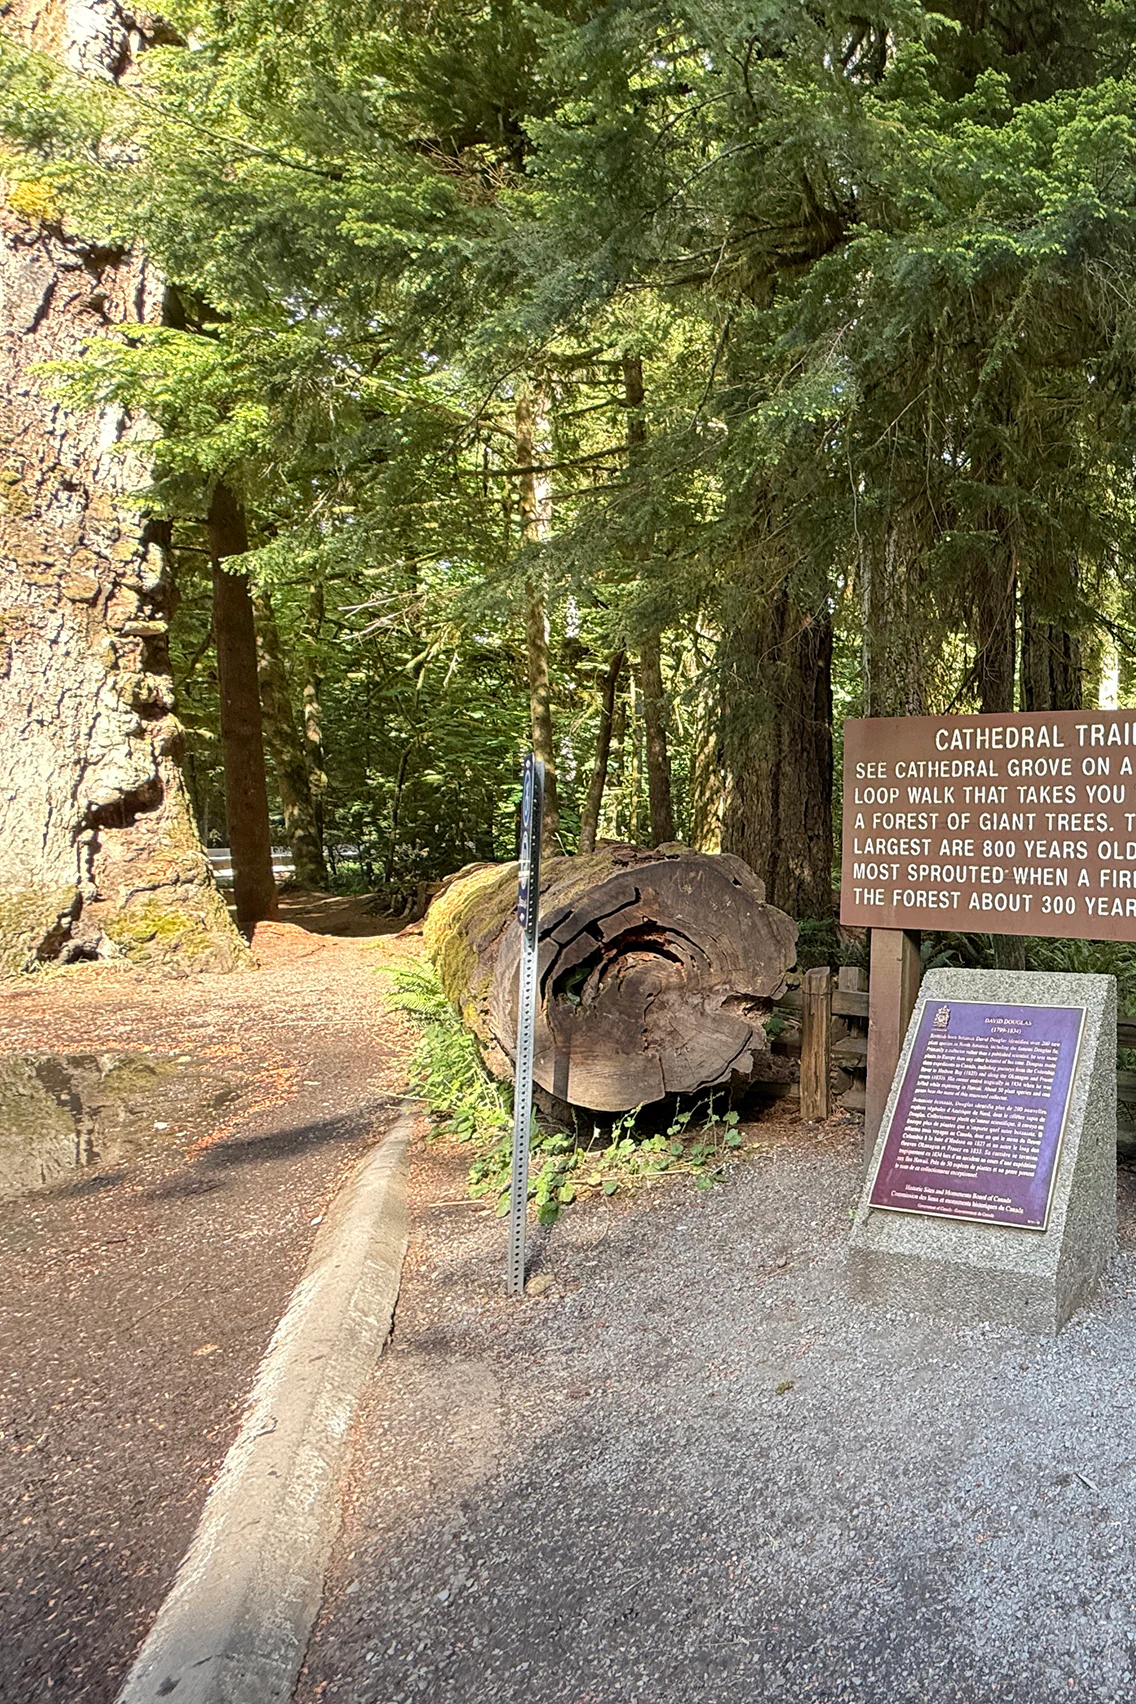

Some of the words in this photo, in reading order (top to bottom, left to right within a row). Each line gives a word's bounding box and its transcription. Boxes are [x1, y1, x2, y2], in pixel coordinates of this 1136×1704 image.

[934, 724, 1065, 751] CATHEDRAL
[855, 761, 887, 779] SEE
[894, 758, 999, 779] CATHEDRAL
[1006, 757, 1072, 777] GROVE
[1081, 756, 1110, 776] ON
[1119, 755, 1133, 775] A
[854, 786, 899, 804] LOOP
[906, 785, 955, 804] WALK
[962, 785, 1008, 804] THAT
[1015, 784, 1076, 804] TAKES
[1085, 783, 1125, 804] YOU
[853, 812, 865, 829] A
[872, 811, 939, 830] FOREST
[946, 811, 971, 830] OF
[978, 811, 1036, 831] GIANT
[1044, 812, 1114, 833] TREES.
[853, 836, 932, 856] LARGEST
[938, 838, 975, 857] ARE
[982, 838, 1016, 858] 800
[1023, 839, 1088, 859] YEARS
[852, 861, 900, 881] MOST
[907, 862, 1004, 884] SPROUTED
[1012, 866, 1068, 886] WHEN
[1076, 867, 1090, 887] A
[852, 887, 885, 905] THE
[892, 888, 961, 909] FOREST
[967, 891, 1033, 912] ABOUT
[1040, 894, 1076, 915] 300
